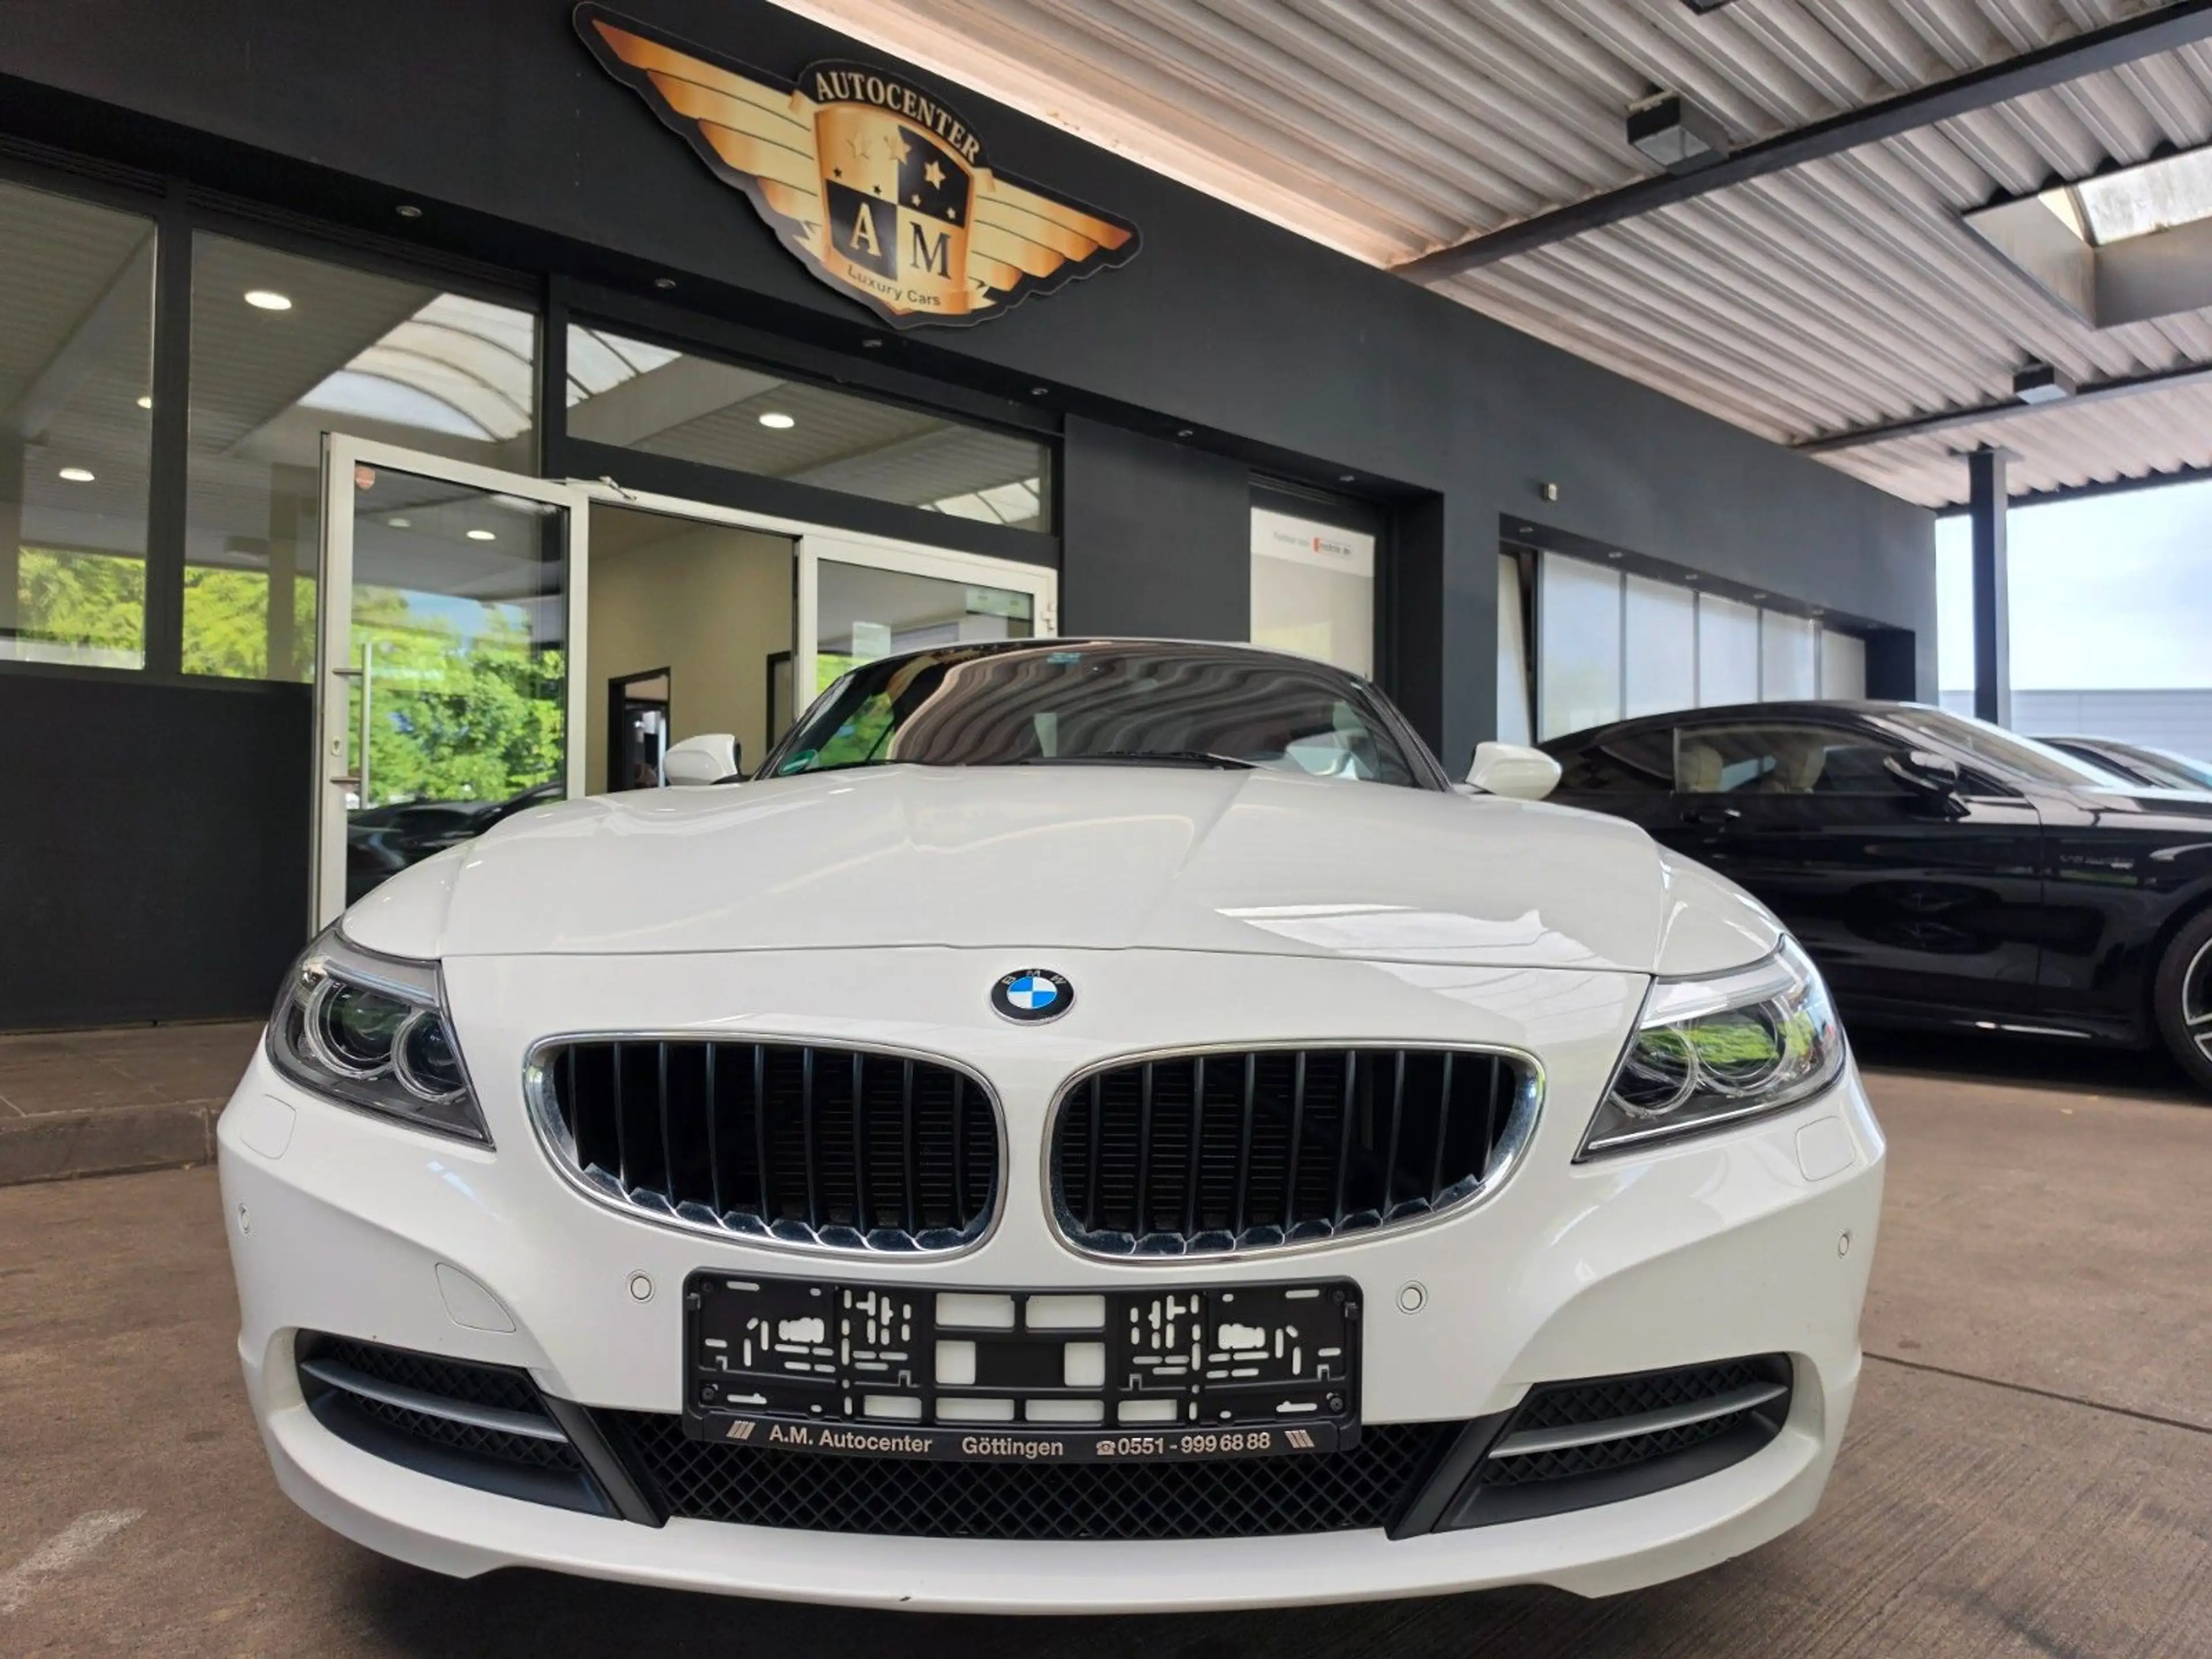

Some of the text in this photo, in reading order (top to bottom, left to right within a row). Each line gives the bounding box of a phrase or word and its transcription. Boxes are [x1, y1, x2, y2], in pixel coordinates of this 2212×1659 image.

[816, 70, 980, 164] AUTOCENTER
[847, 264, 941, 306] Luxury Cars
[768, 1424, 814, 1445] A.M.
[819, 1429, 933, 1453] Autocenter
[961, 1435, 1064, 1460] Göttingen
